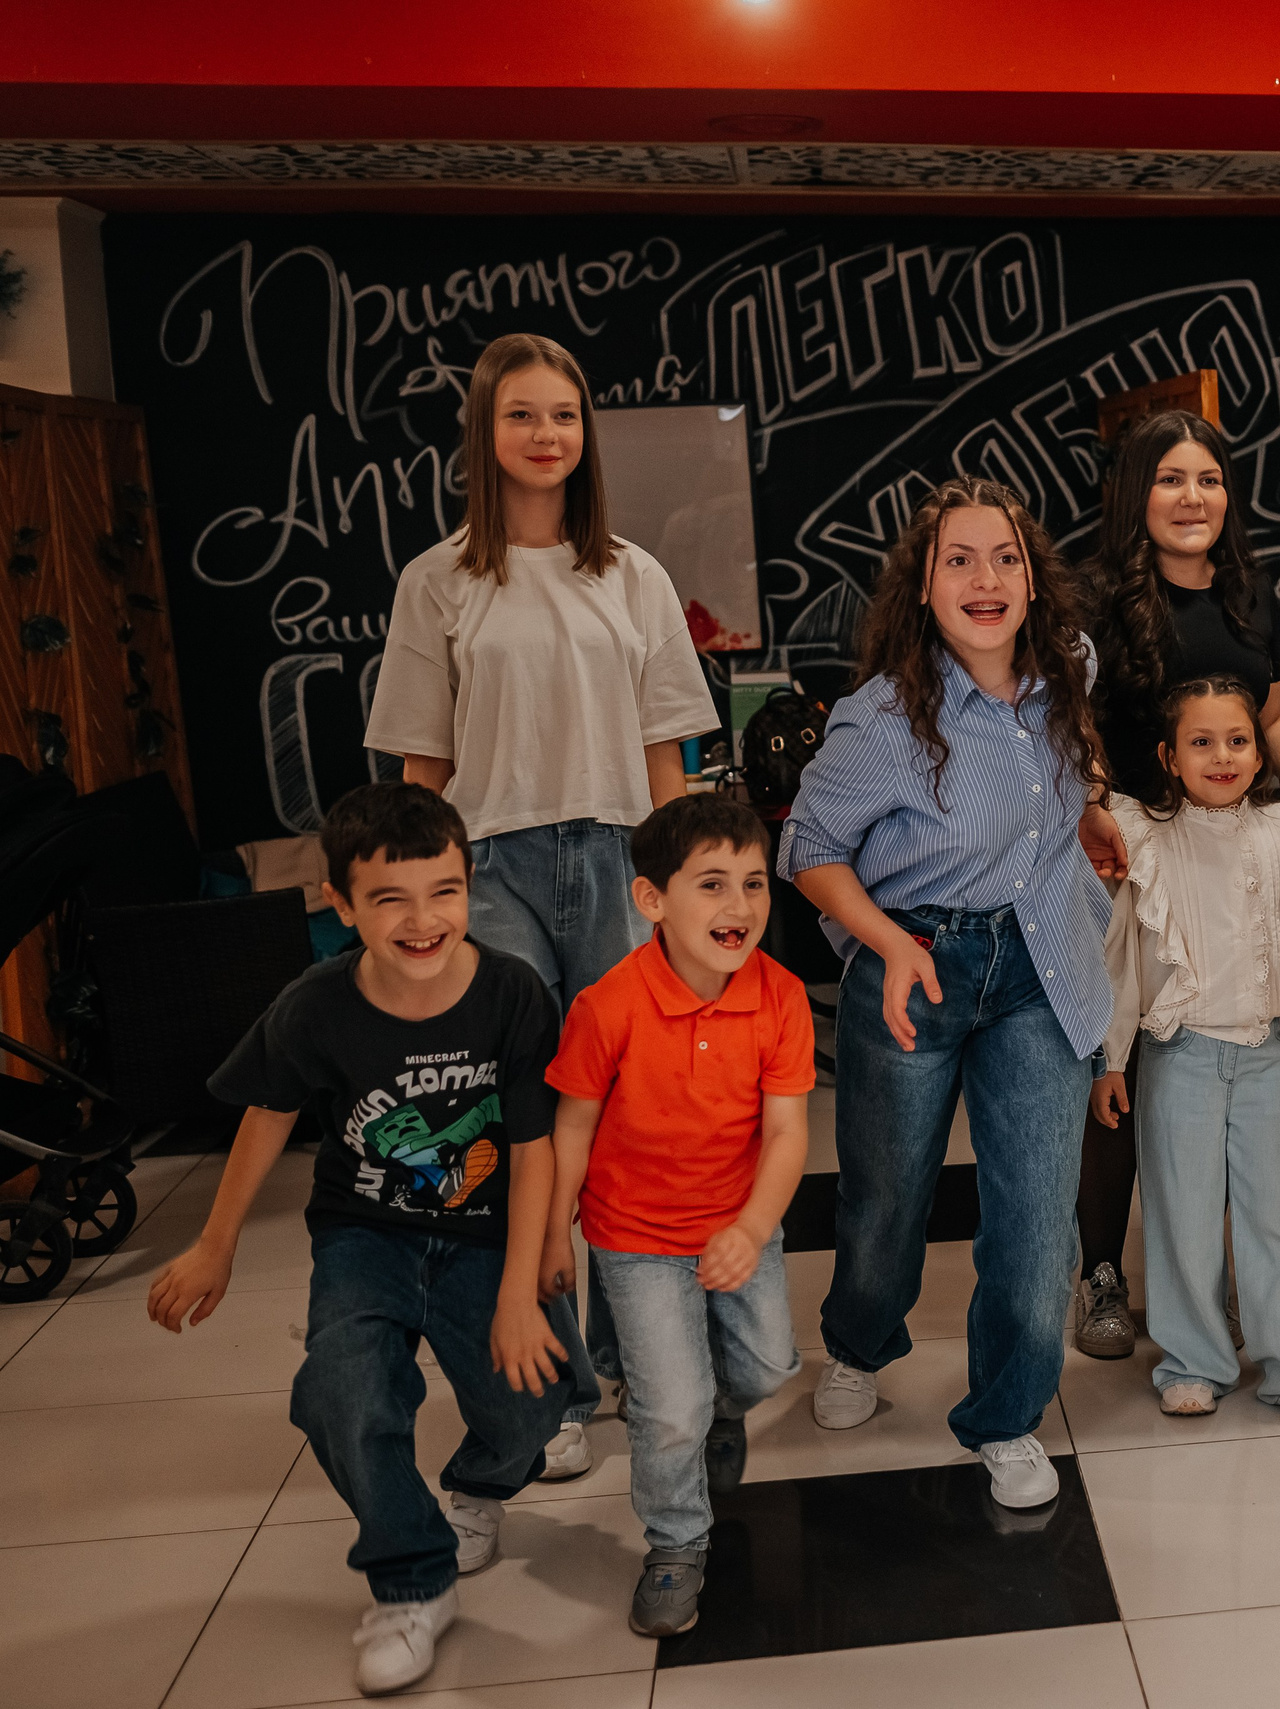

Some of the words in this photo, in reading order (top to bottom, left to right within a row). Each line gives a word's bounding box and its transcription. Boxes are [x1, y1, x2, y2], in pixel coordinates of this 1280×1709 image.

[159, 236, 681, 443] Приятного
[707, 232, 1044, 425] ЛЕГКО
[405, 1050, 470, 1065] MINECRAFT
